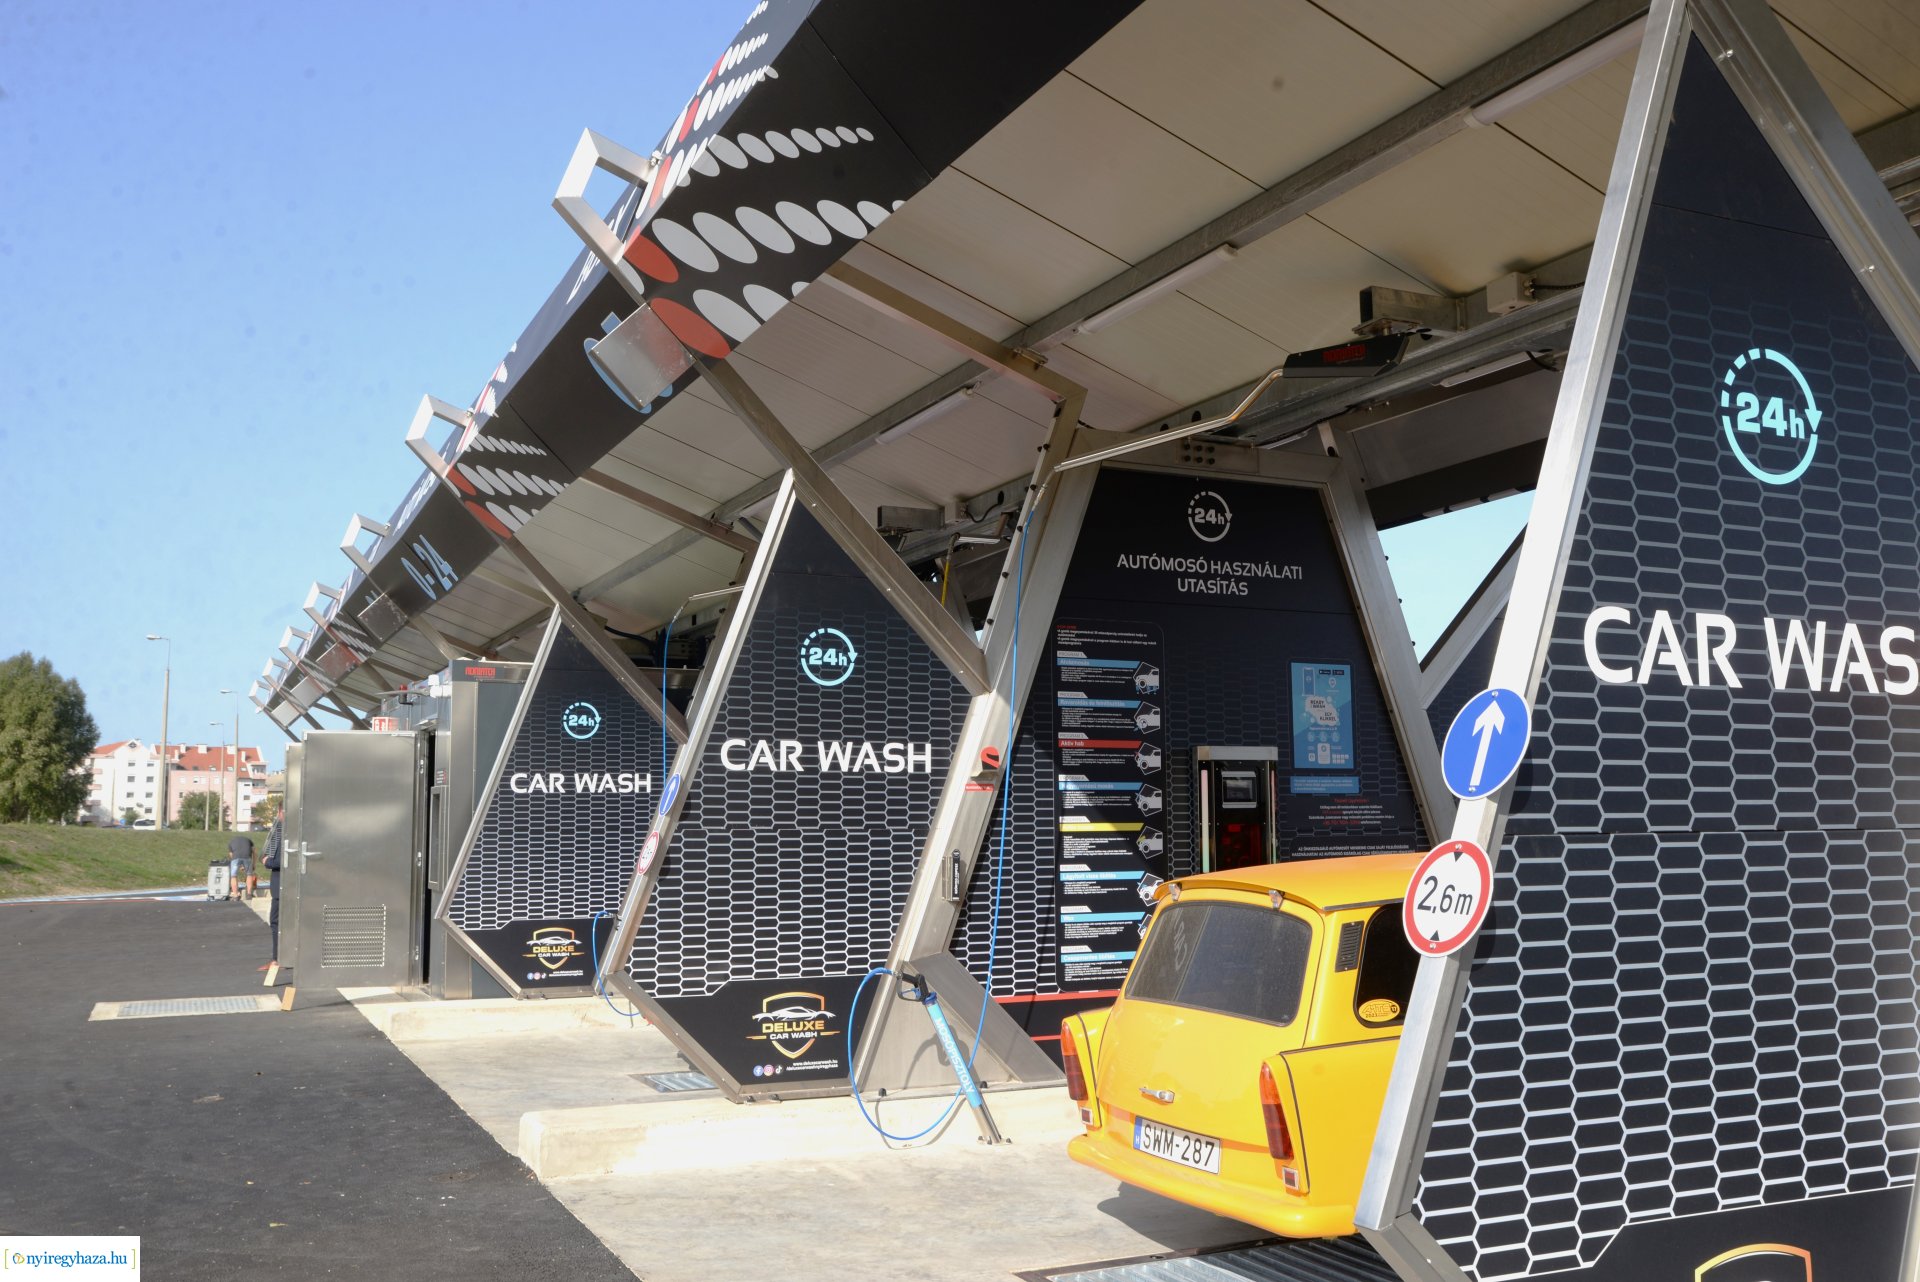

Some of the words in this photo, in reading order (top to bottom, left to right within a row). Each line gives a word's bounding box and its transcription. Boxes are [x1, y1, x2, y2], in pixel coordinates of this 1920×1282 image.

[1736, 391, 1805, 440] 24h
[1194, 507, 1225, 525] 24h
[1117, 553, 1208, 574] AUTÓMOSÓ
[1210, 561, 1302, 580] HASZNÁLATI
[1177, 577, 1249, 596] UTASÍTÁS
[1584, 606, 1743, 688] CAR
[809, 647, 848, 667] 24h
[568, 714, 595, 729] 24h
[720, 738, 804, 772] CAR
[817, 741, 932, 773] WASH
[510, 773, 566, 794] CAR
[574, 773, 652, 794] WASH
[533, 945, 575, 953] DELUXE
[762, 1020, 825, 1034] DELUXE
[769, 1032, 789, 1040] CAR
[791, 1031, 818, 1039] WASH
[1135, 1135, 1140, 1145] H
[1143, 1123, 1215, 1167] SWM-287
